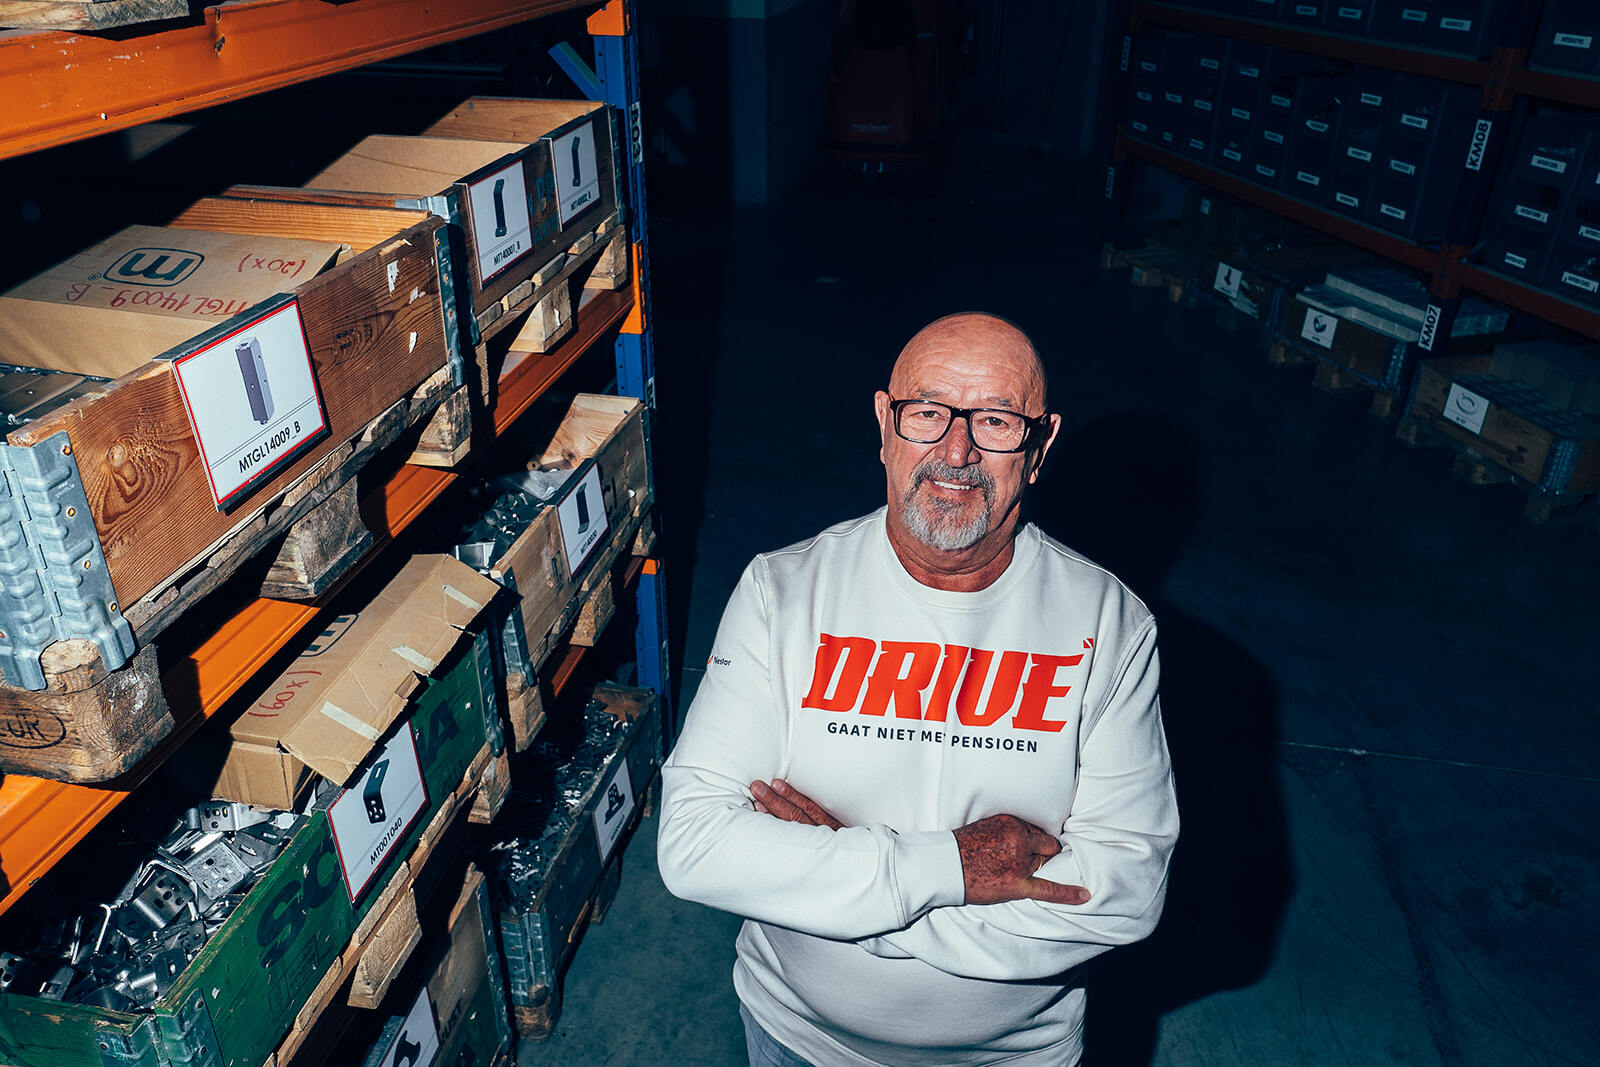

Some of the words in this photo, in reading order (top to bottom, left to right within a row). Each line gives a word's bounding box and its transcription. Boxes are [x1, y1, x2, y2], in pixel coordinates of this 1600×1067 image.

[1469, 122, 1488, 168] KM08
[1421, 305, 1437, 347] KM07
[239, 421, 301, 473] MTGL14009_B
[827, 722, 871, 737] GAAT
[877, 727, 916, 741] NIET
[921, 730, 946, 743] ME
[951, 735, 1038, 752] PENSIOEN
[370, 817, 402, 865] MT001040
